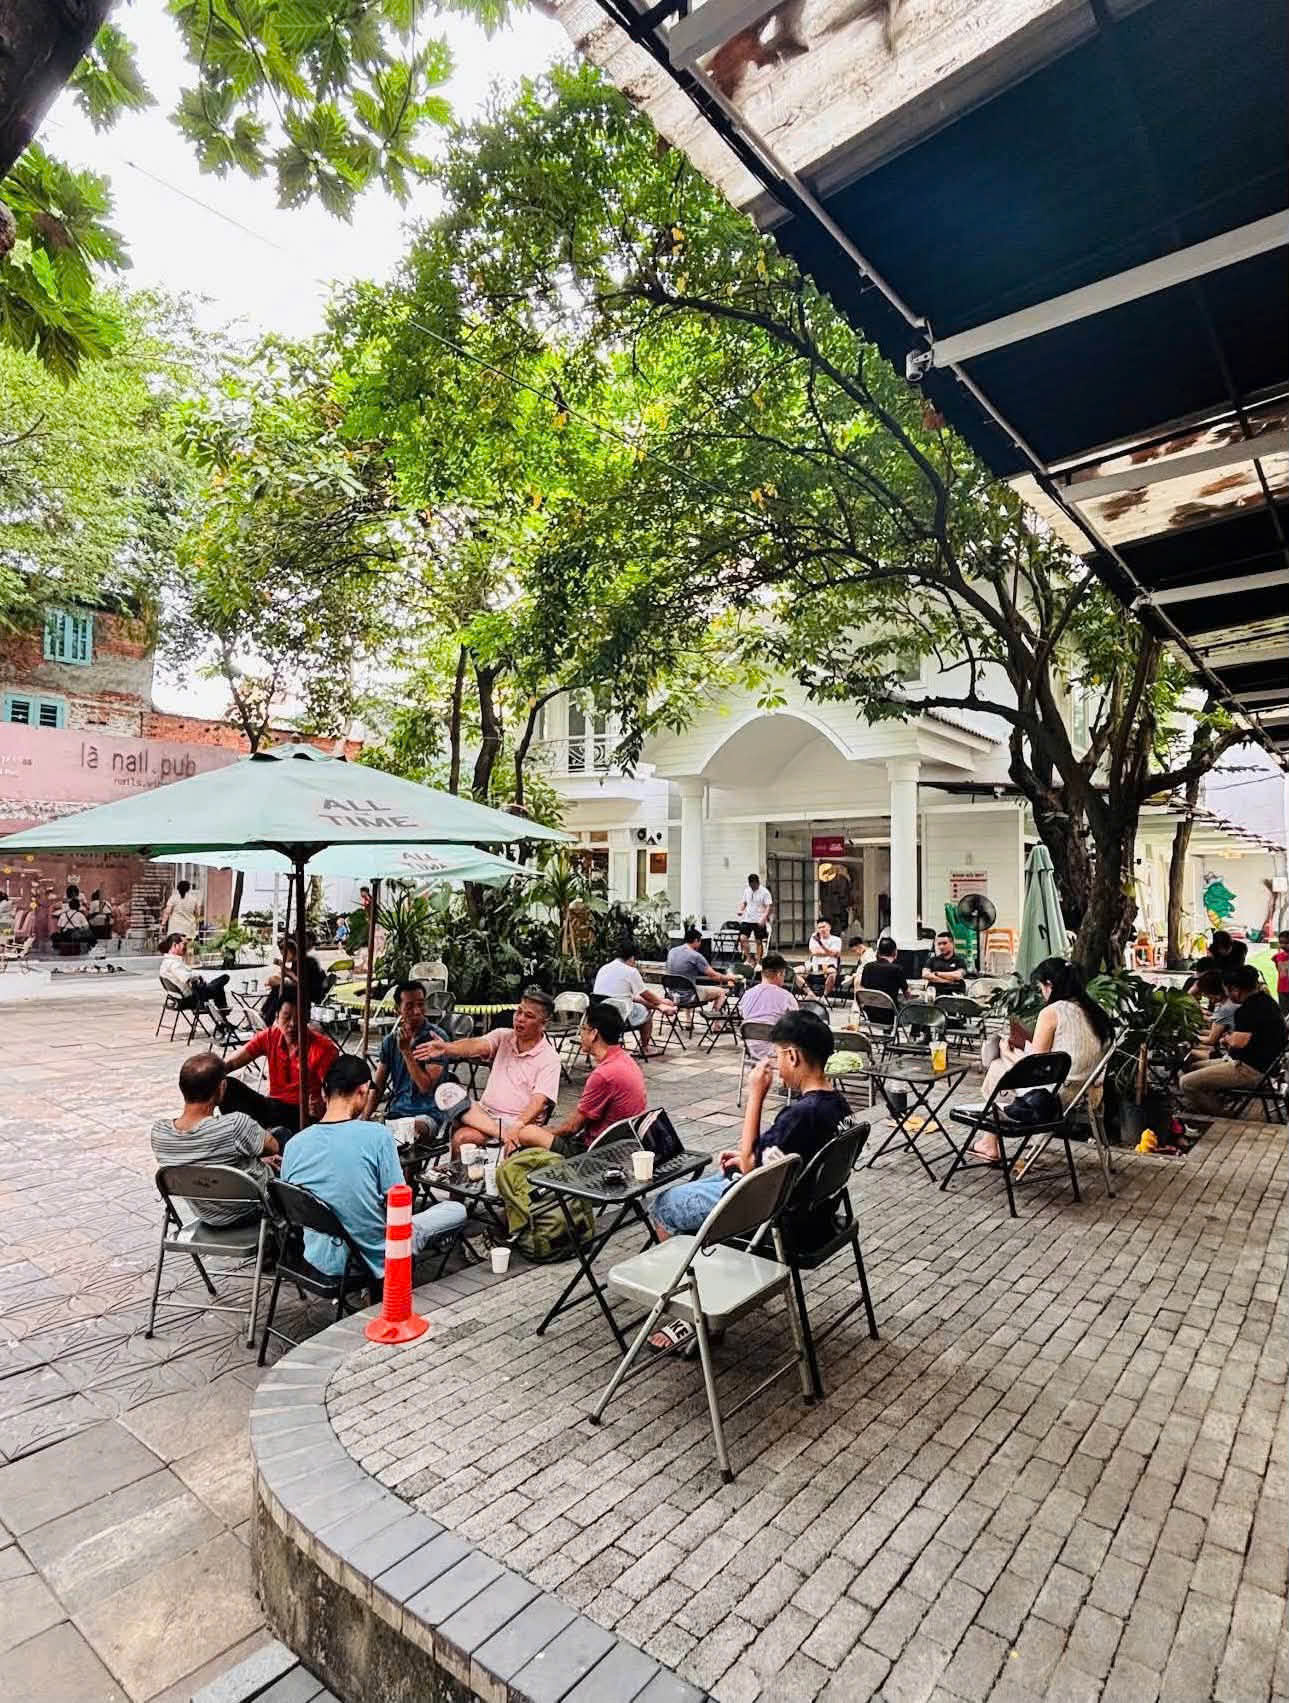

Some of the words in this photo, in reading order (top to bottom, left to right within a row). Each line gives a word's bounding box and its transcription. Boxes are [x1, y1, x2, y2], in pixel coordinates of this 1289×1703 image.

[323, 798, 392, 812] ALL
[318, 814, 420, 828] TIME
[402, 852, 440, 861] ALL
